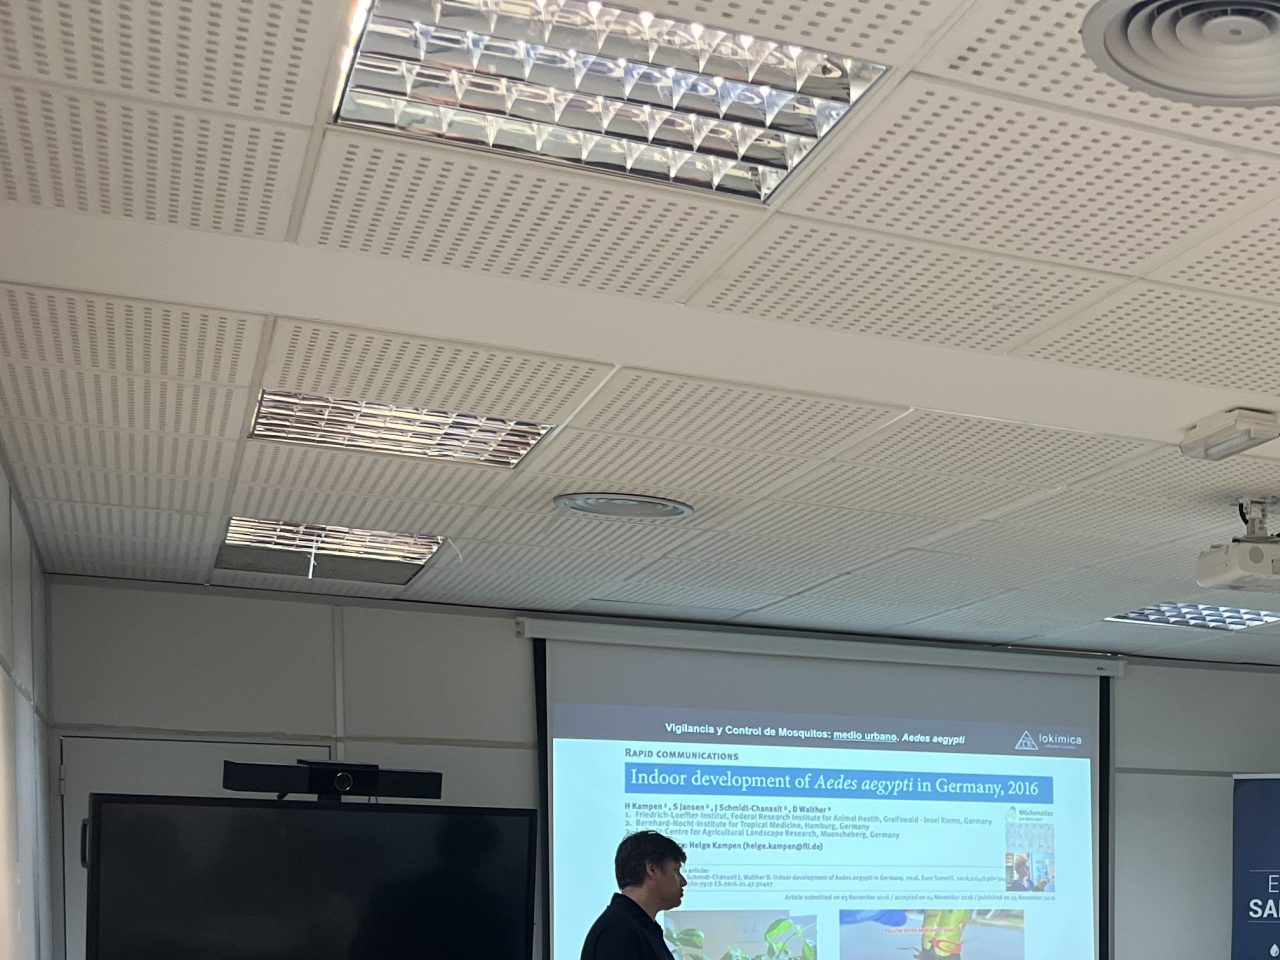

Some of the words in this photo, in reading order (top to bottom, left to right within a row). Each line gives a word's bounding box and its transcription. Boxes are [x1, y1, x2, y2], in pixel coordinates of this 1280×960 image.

[665, 722, 714, 734] Vigilancia
[717, 727, 723, 735] y
[725, 725, 762, 736] Control
[764, 727, 776, 736] de
[778, 728, 832, 740] Mosquitos:
[833, 731, 862, 741] medio
[864, 732, 900, 743] urbano.
[902, 733, 931, 743] Aedes
[932, 735, 965, 746] aegypti
[624, 748, 654, 758] RAPID
[656, 751, 739, 761] COMMUNICATIONS
[630, 768, 687, 785] Indoor
[691, 769, 791, 791] development
[794, 773, 813, 789] of
[814, 775, 858, 790] Aedes
[861, 776, 914, 795] aegypti
[917, 778, 932, 792] in
[935, 778, 1005, 798] Germany,
[1007, 781, 1039, 796] 2016
[625, 802, 631, 810] H
[632, 803, 663, 812] Kampen
[673, 803, 679, 811] S
[680, 803, 705, 812] Jansen
[719, 804, 783, 813] Schmidt-Chanasit
[799, 806, 827, 814] Walther
[636, 820, 728, 828] Bernhard-Nocht-Institute
[729, 820, 739, 828] for
[740, 821, 768, 830] Tropical
[770, 822, 804, 830] Medicine,
[804, 822, 838, 831] Hamburg,
[839, 822, 870, 832] Germany
[731, 812, 757, 821] Federal
[758, 812, 791, 821] Research
[792, 813, 821, 822] Institute
[822, 814, 832, 822] for
[833, 815, 856, 823] Animal
[858, 815, 883, 824] Health,
[883, 816, 919, 825] Greifswald
[924, 817, 941, 825] Insel
[964, 818, 993, 828] Germany
[702, 829, 745, 837] Agricultural
[746, 829, 784, 838] Landscape
[785, 830, 819, 838] Research,
[870, 831, 900, 841] Germany
[689, 842, 711, 851] Helge
[713, 843, 742, 852] Kampen
